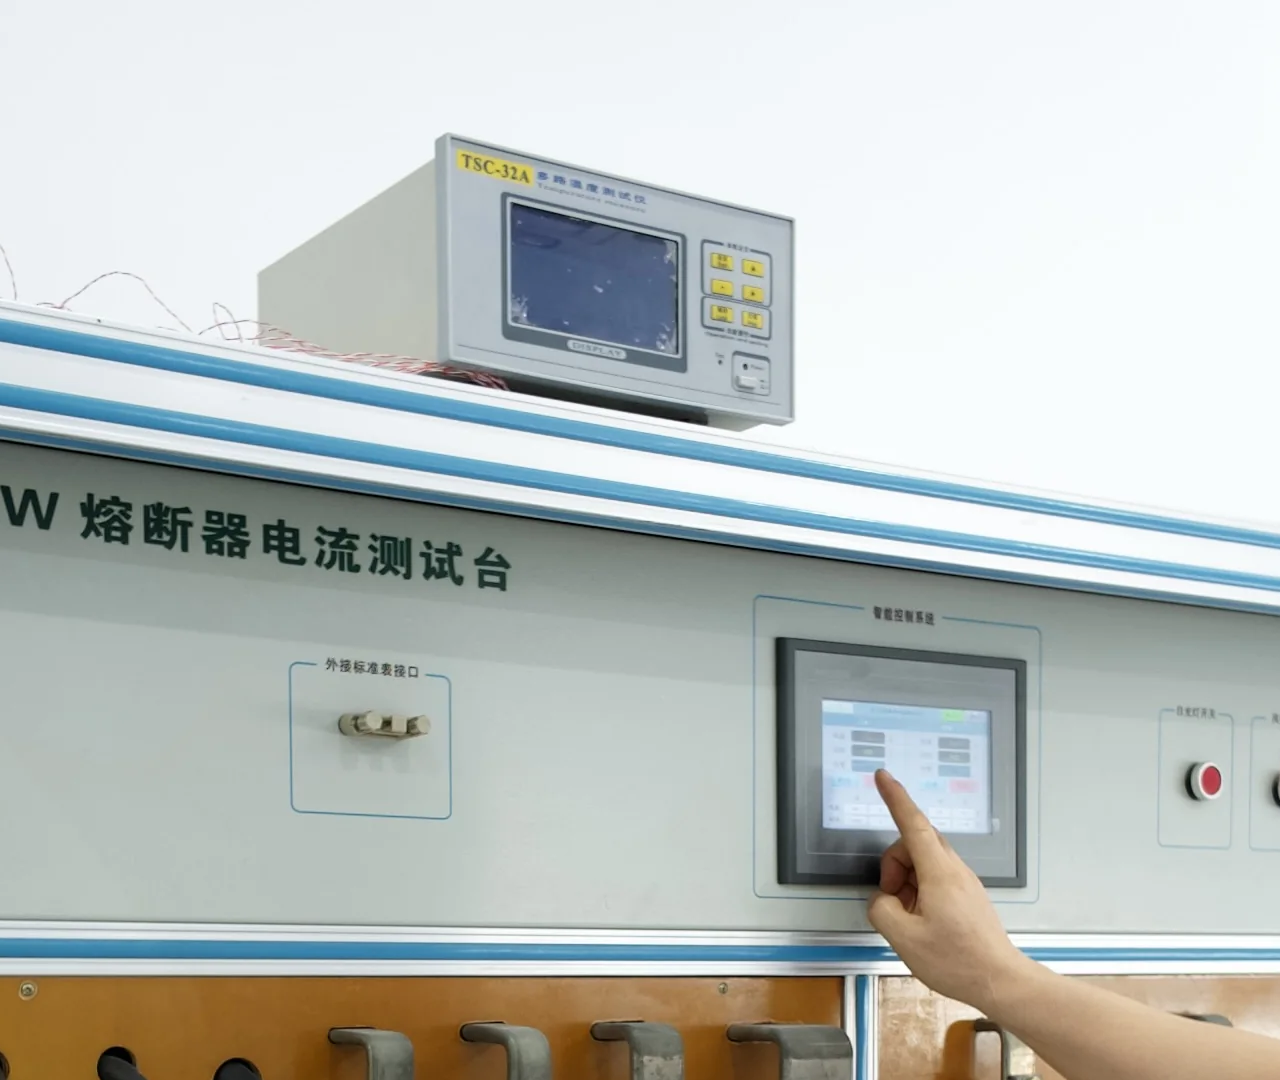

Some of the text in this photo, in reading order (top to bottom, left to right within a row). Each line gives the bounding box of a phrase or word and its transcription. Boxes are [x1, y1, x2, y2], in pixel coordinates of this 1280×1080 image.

[460, 153, 531, 184] TSC-32A
[572, 342, 623, 357] DISPLAY
[79, 492, 513, 592] 熔断器电流测试台
[873, 605, 936, 626] 智能控制系统
[325, 657, 420, 679] 外接标准表接口
